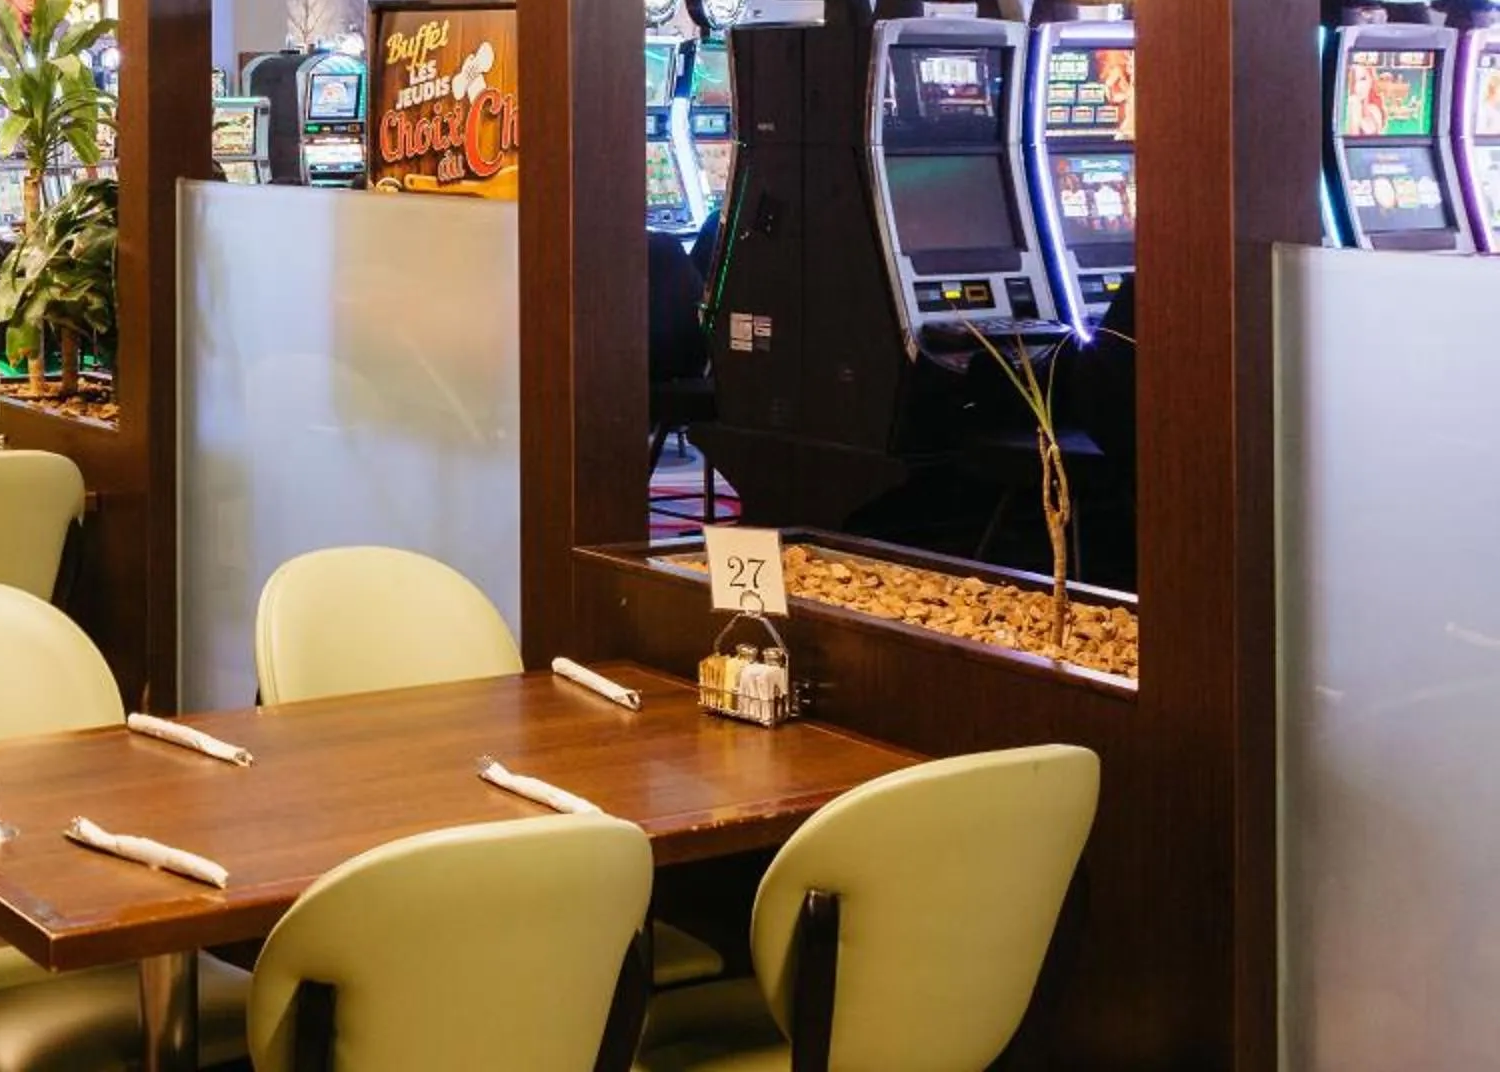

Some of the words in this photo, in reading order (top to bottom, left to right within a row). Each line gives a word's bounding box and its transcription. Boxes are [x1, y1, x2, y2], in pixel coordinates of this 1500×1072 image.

[386, 20, 450, 70] Buffet
[409, 59, 437, 86] LES
[395, 76, 450, 110] JEUDIS
[380, 101, 465, 163] Choix
[438, 150, 465, 181] du
[727, 556, 766, 589] 27
